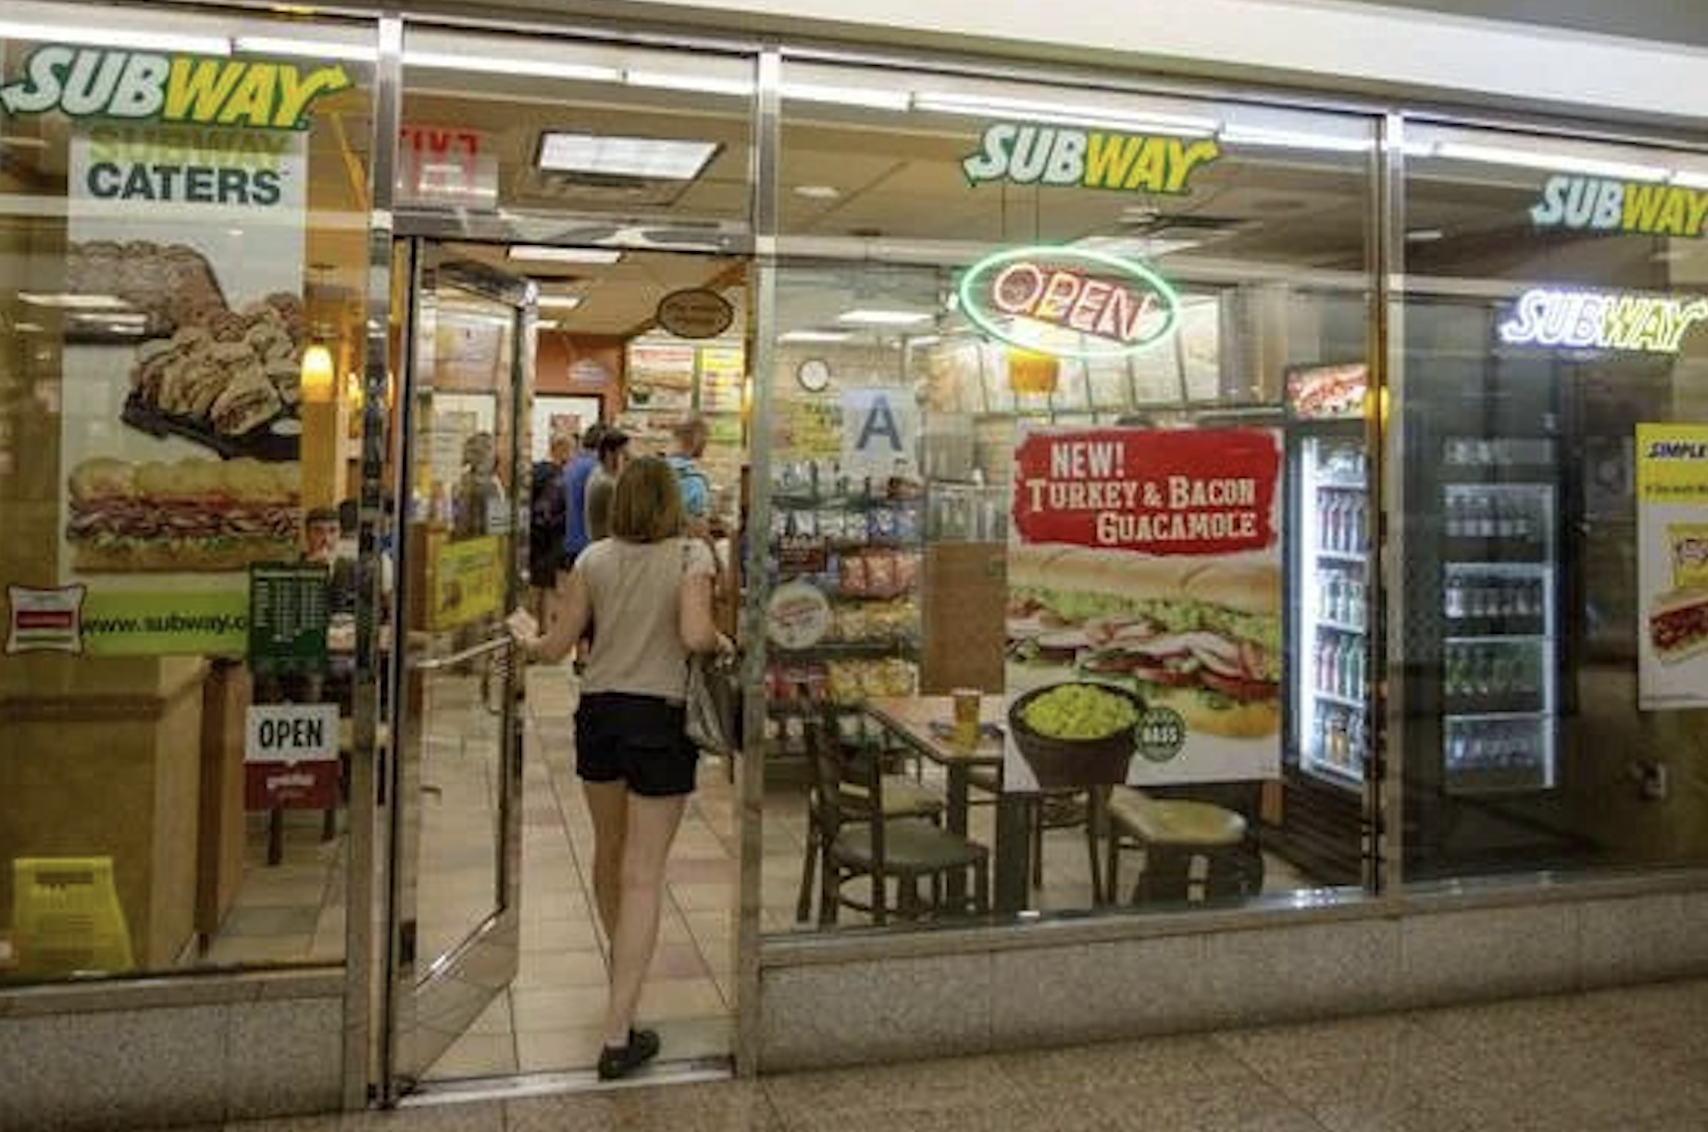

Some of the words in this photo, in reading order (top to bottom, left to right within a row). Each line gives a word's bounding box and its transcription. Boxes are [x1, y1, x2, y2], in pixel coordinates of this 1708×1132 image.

[1, 46, 352, 130] SUBWAY
[87, 162, 282, 206] CATERS
[963, 123, 1220, 194] SUBWAY
[1531, 175, 1708, 236] SUBWAY
[993, 261, 1156, 343] OPEN
[1499, 287, 1708, 352] SUBWAY
[856, 394, 903, 452] A
[1050, 440, 1125, 479] NEW!
[1026, 477, 1137, 512] TURKEY
[1143, 480, 1162, 507] &
[1167, 475, 1256, 509] BACON
[1097, 510, 1258, 545] GUACAMOLE
[259, 718, 323, 750] OPEN
